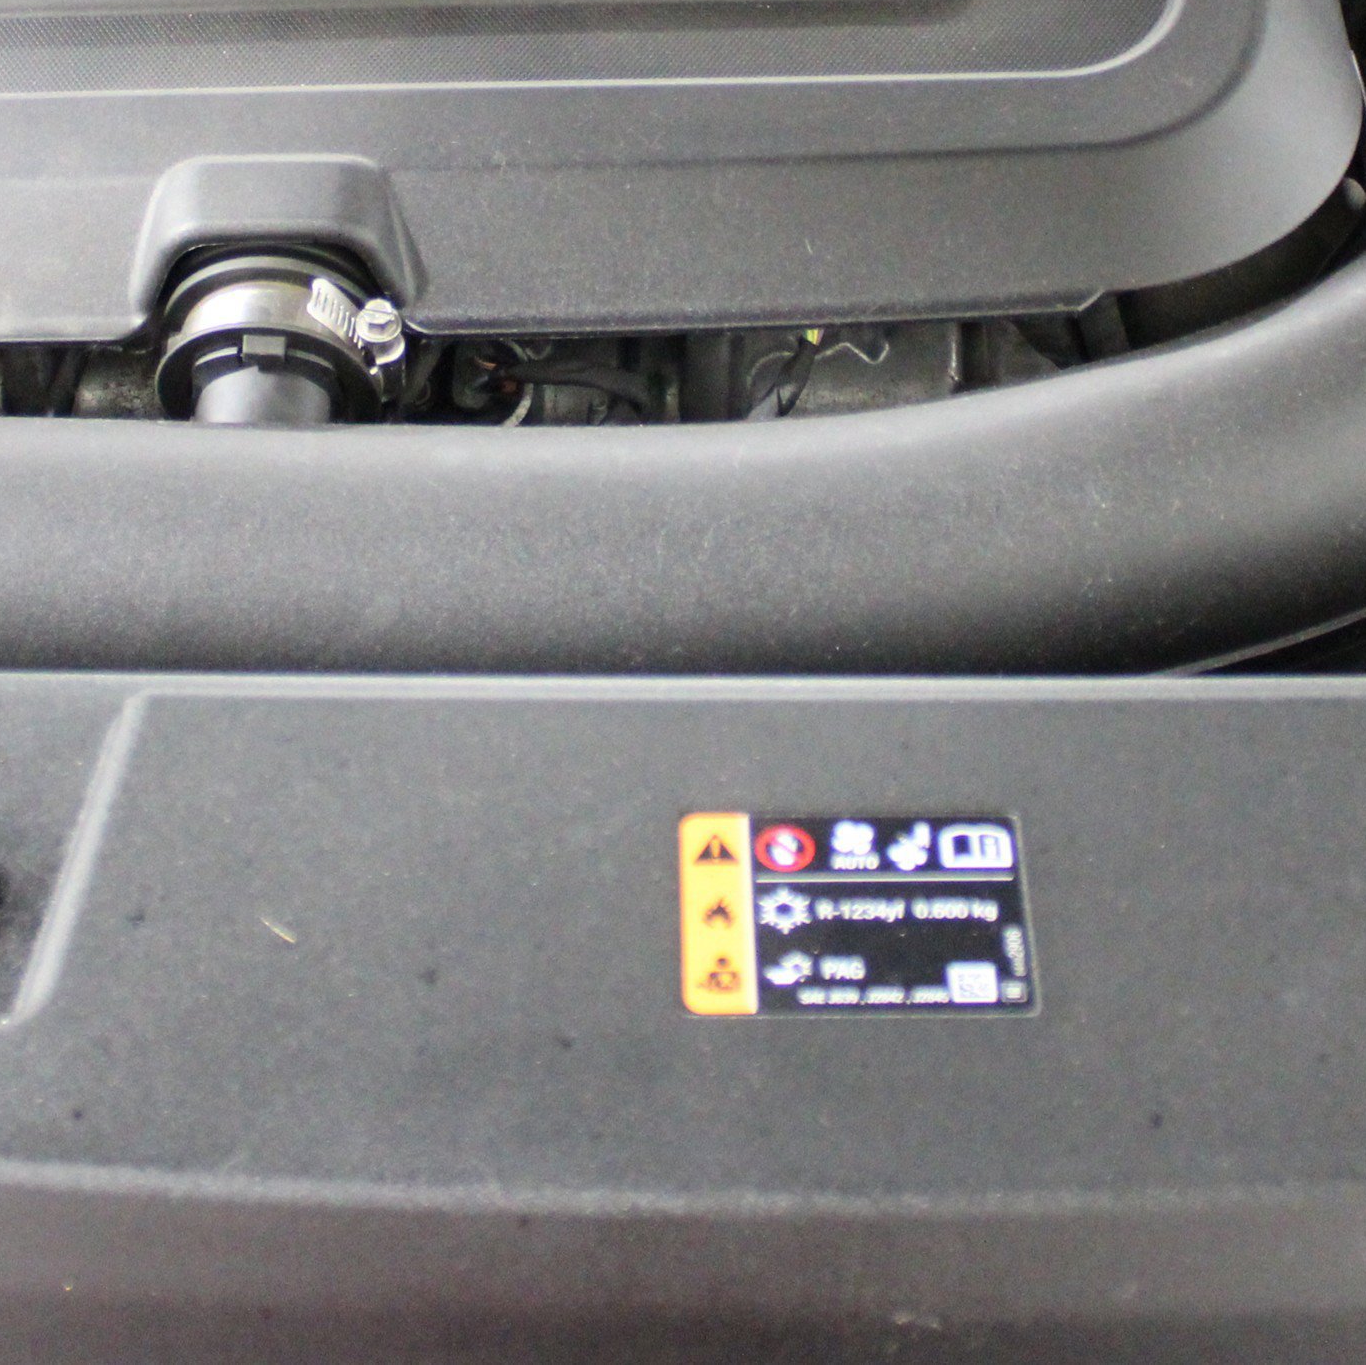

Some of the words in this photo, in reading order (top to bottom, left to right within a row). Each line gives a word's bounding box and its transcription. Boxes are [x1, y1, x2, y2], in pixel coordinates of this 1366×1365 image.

[833, 854, 879, 870] AUTO
[815, 899, 905, 923] R-1234yf
[912, 900, 969, 920] 0.600
[972, 900, 999, 922] kg
[820, 957, 866, 980] PAG
